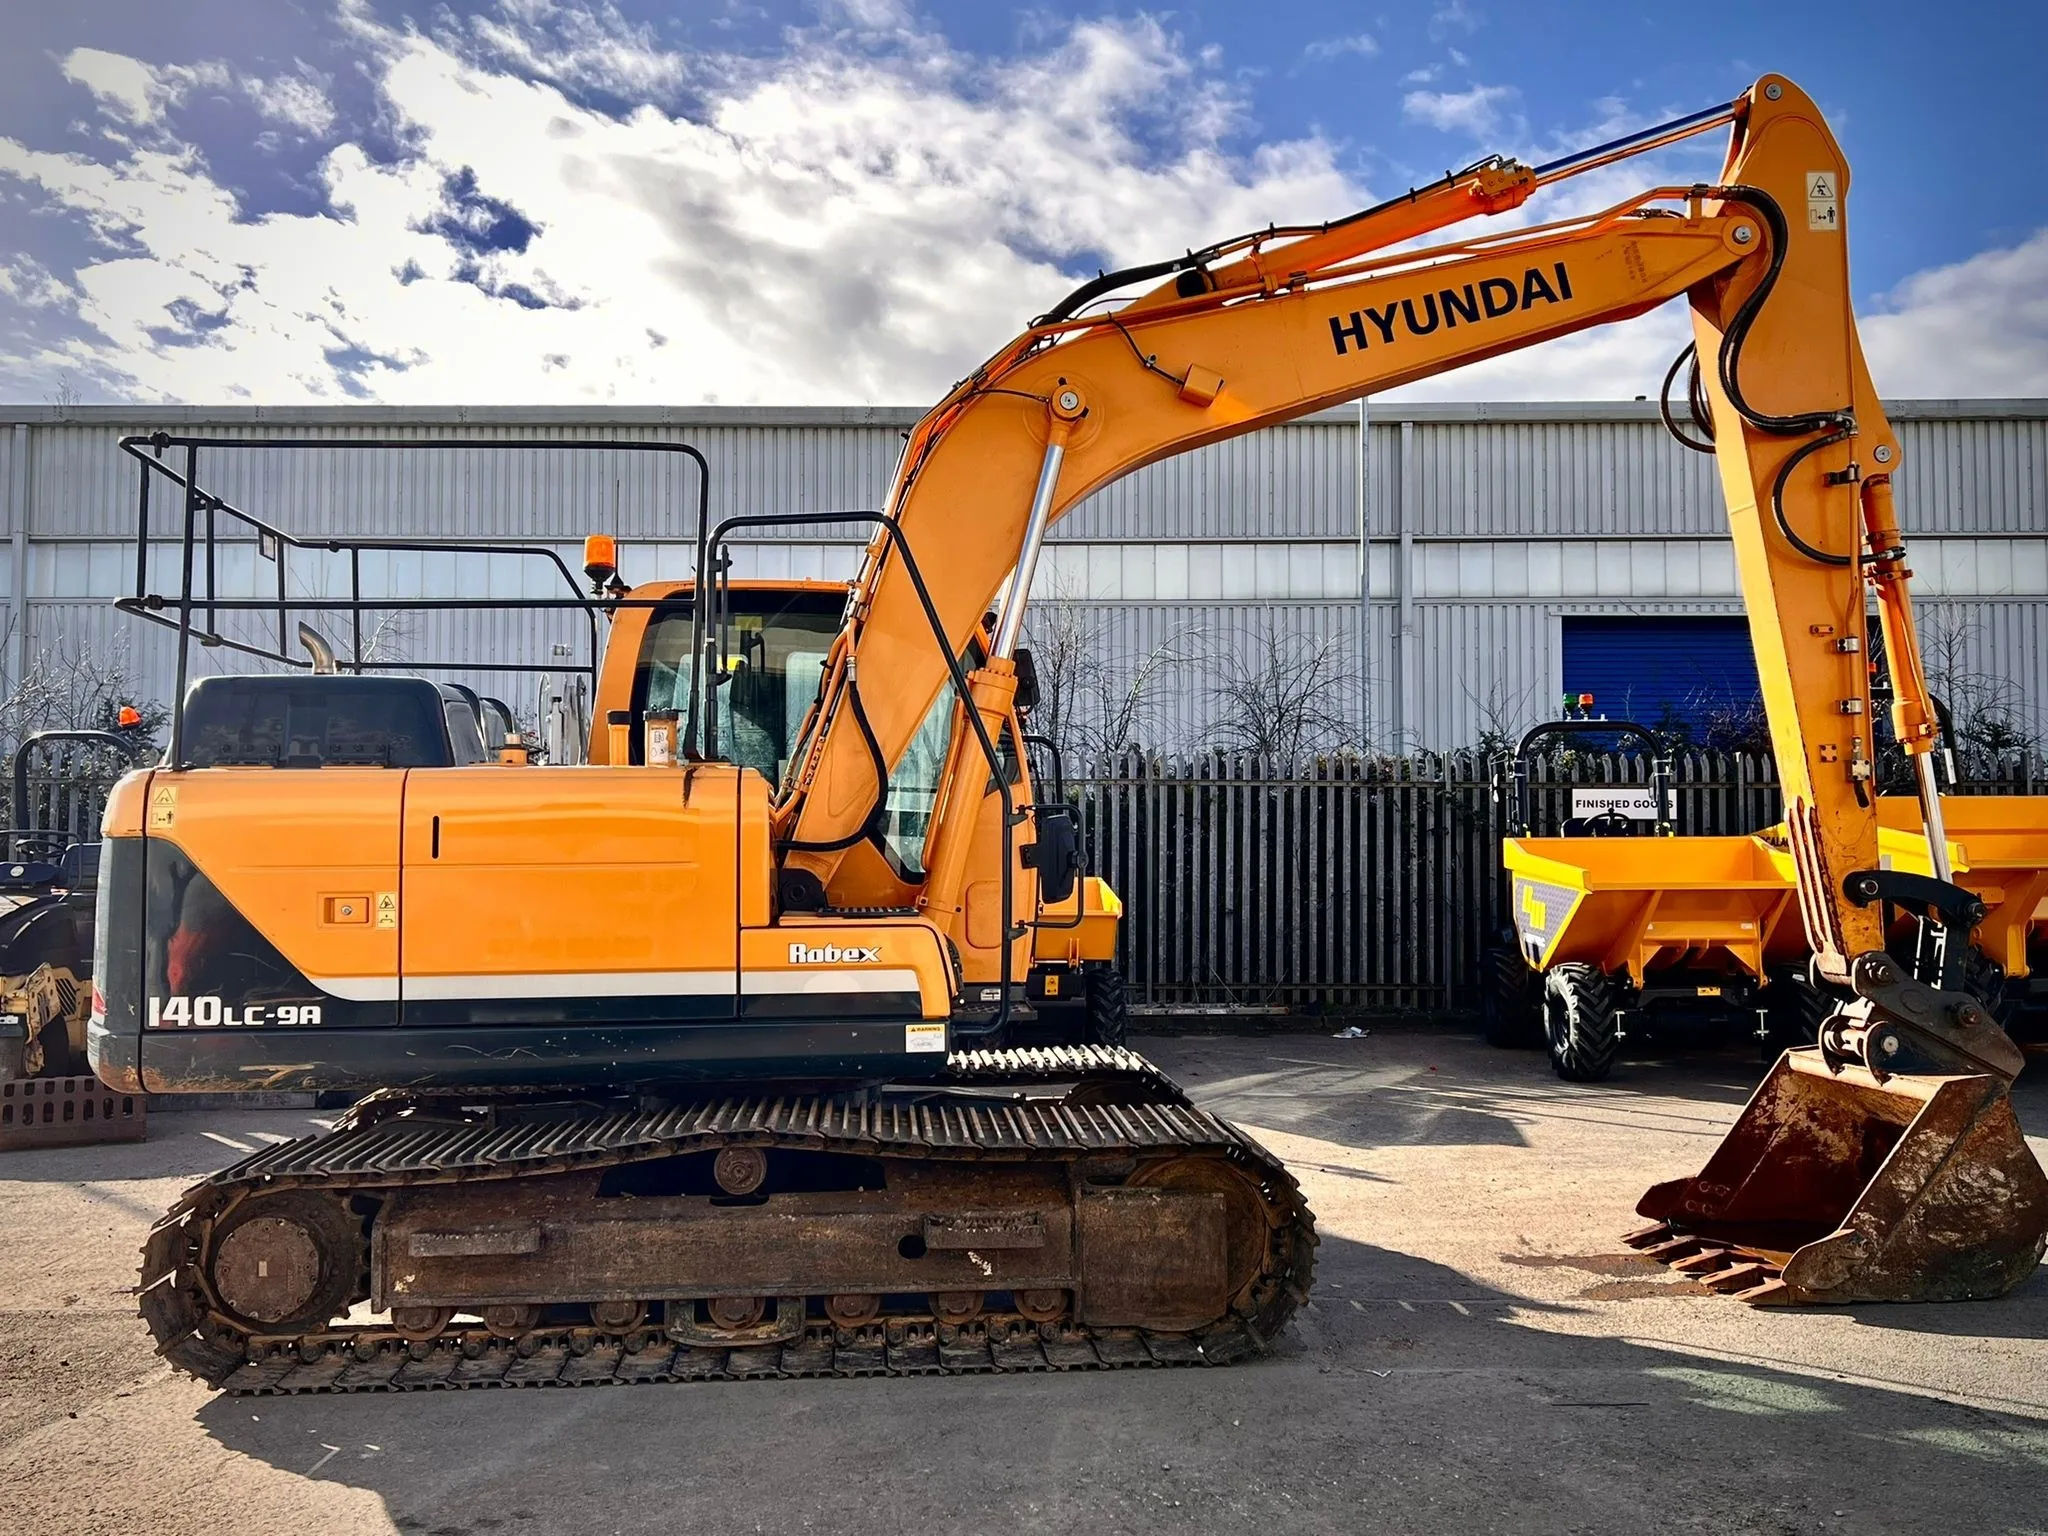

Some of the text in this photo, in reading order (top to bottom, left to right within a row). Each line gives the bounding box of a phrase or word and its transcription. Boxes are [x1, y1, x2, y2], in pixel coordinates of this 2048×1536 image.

[1328, 261, 1573, 356] HYUNDAI
[1576, 799, 1674, 808] FINISHED GOOS
[788, 942, 882, 964] Robex
